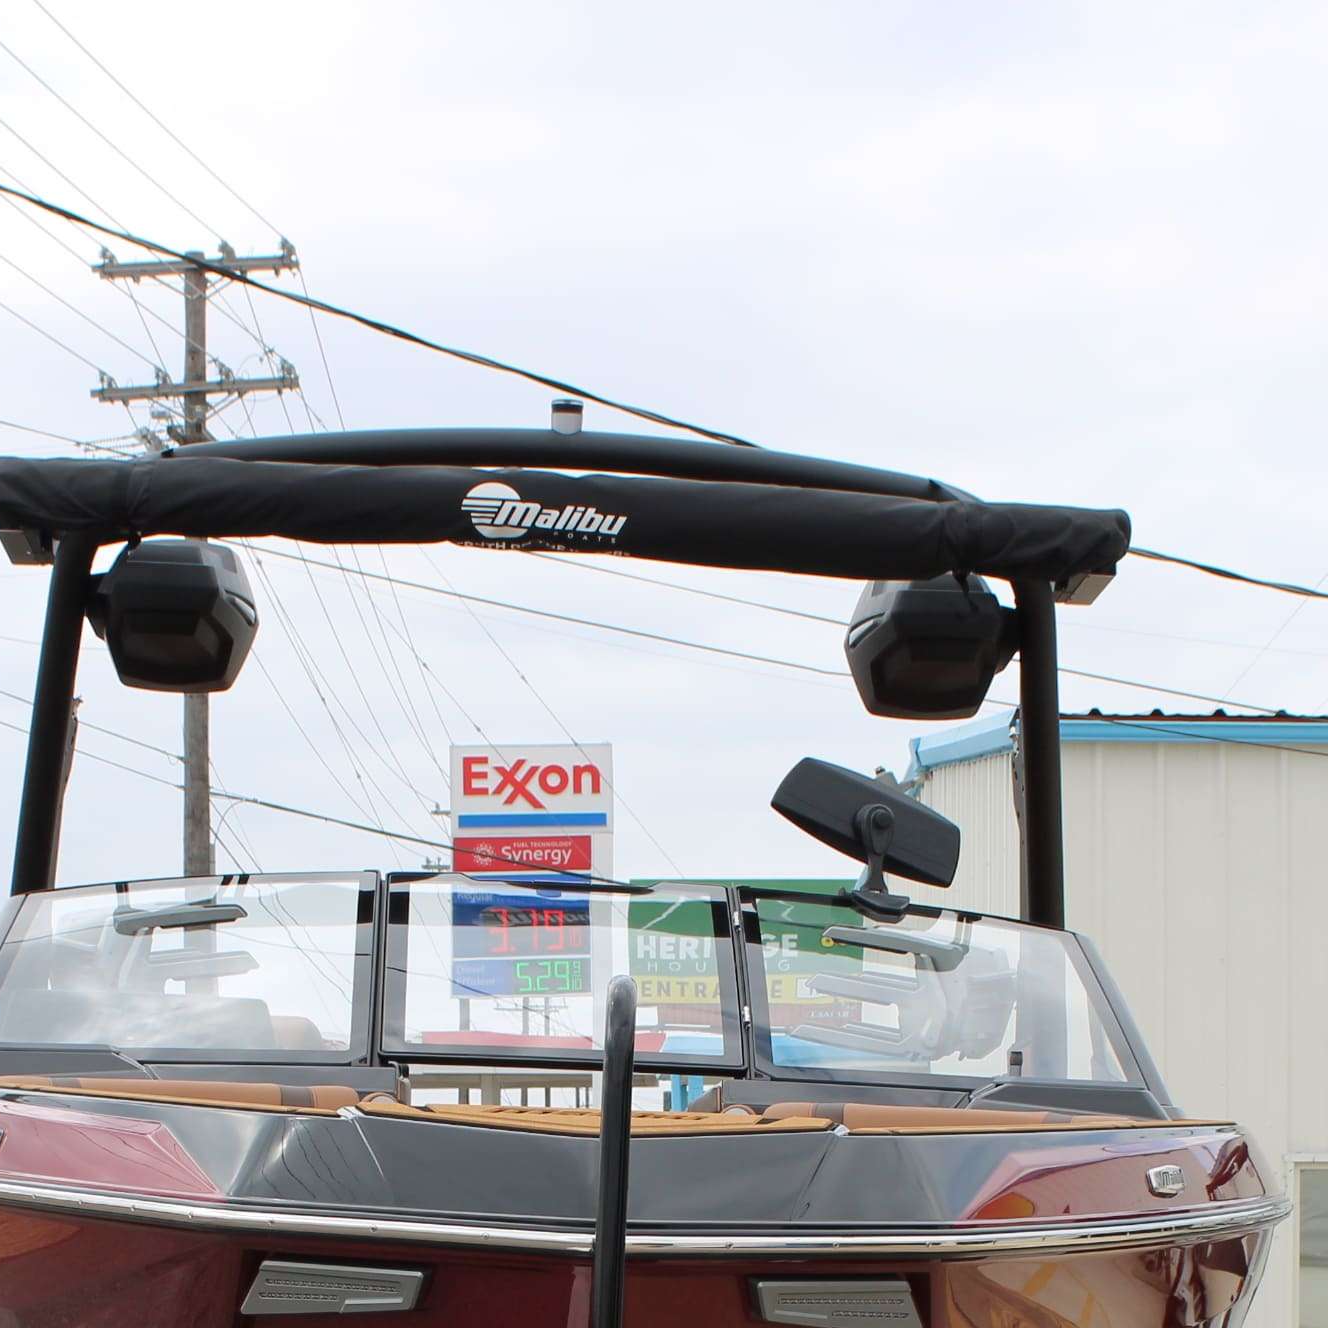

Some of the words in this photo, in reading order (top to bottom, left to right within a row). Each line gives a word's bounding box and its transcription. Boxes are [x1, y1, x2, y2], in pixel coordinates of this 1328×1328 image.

[493, 500, 628, 536] Malibu
[462, 756, 602, 809] Exxon
[501, 846, 572, 865] Synergy
[638, 935, 799, 959] HERIGE
